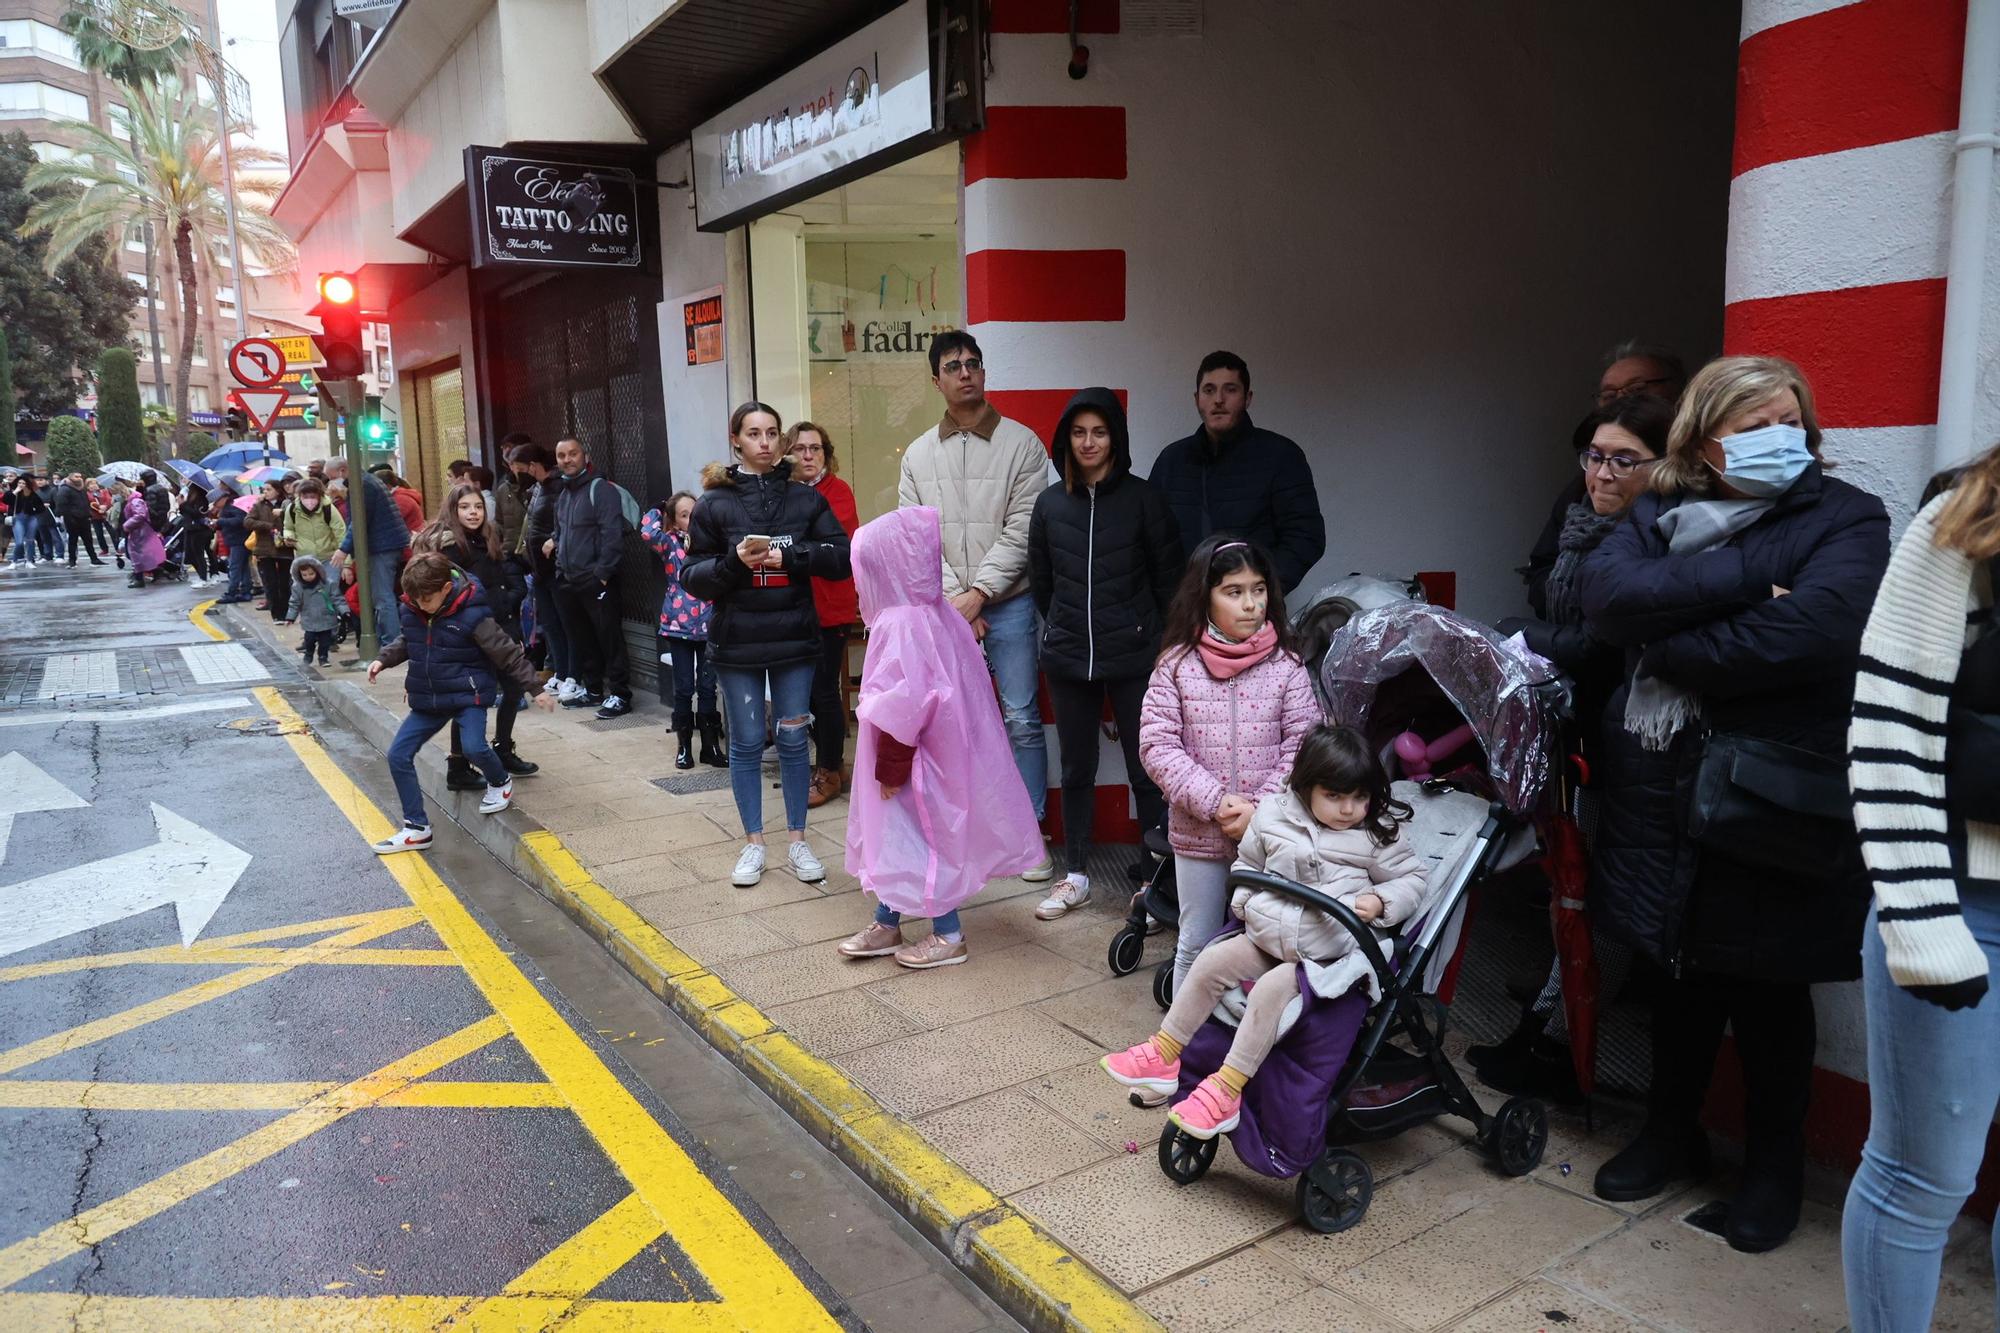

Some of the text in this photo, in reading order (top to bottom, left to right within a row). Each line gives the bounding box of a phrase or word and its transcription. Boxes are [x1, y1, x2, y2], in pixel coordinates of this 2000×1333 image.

[514, 166, 607, 203] Elecc
[495, 205, 629, 236] TATTOING
[608, 245, 627, 255] 2002
[685, 299, 721, 326] SE ALQUILA
[878, 320, 905, 332] Colla
[294, 339, 305, 348] EN
[287, 351, 307, 360] REAL
[278, 406, 304, 417] ENTRE
